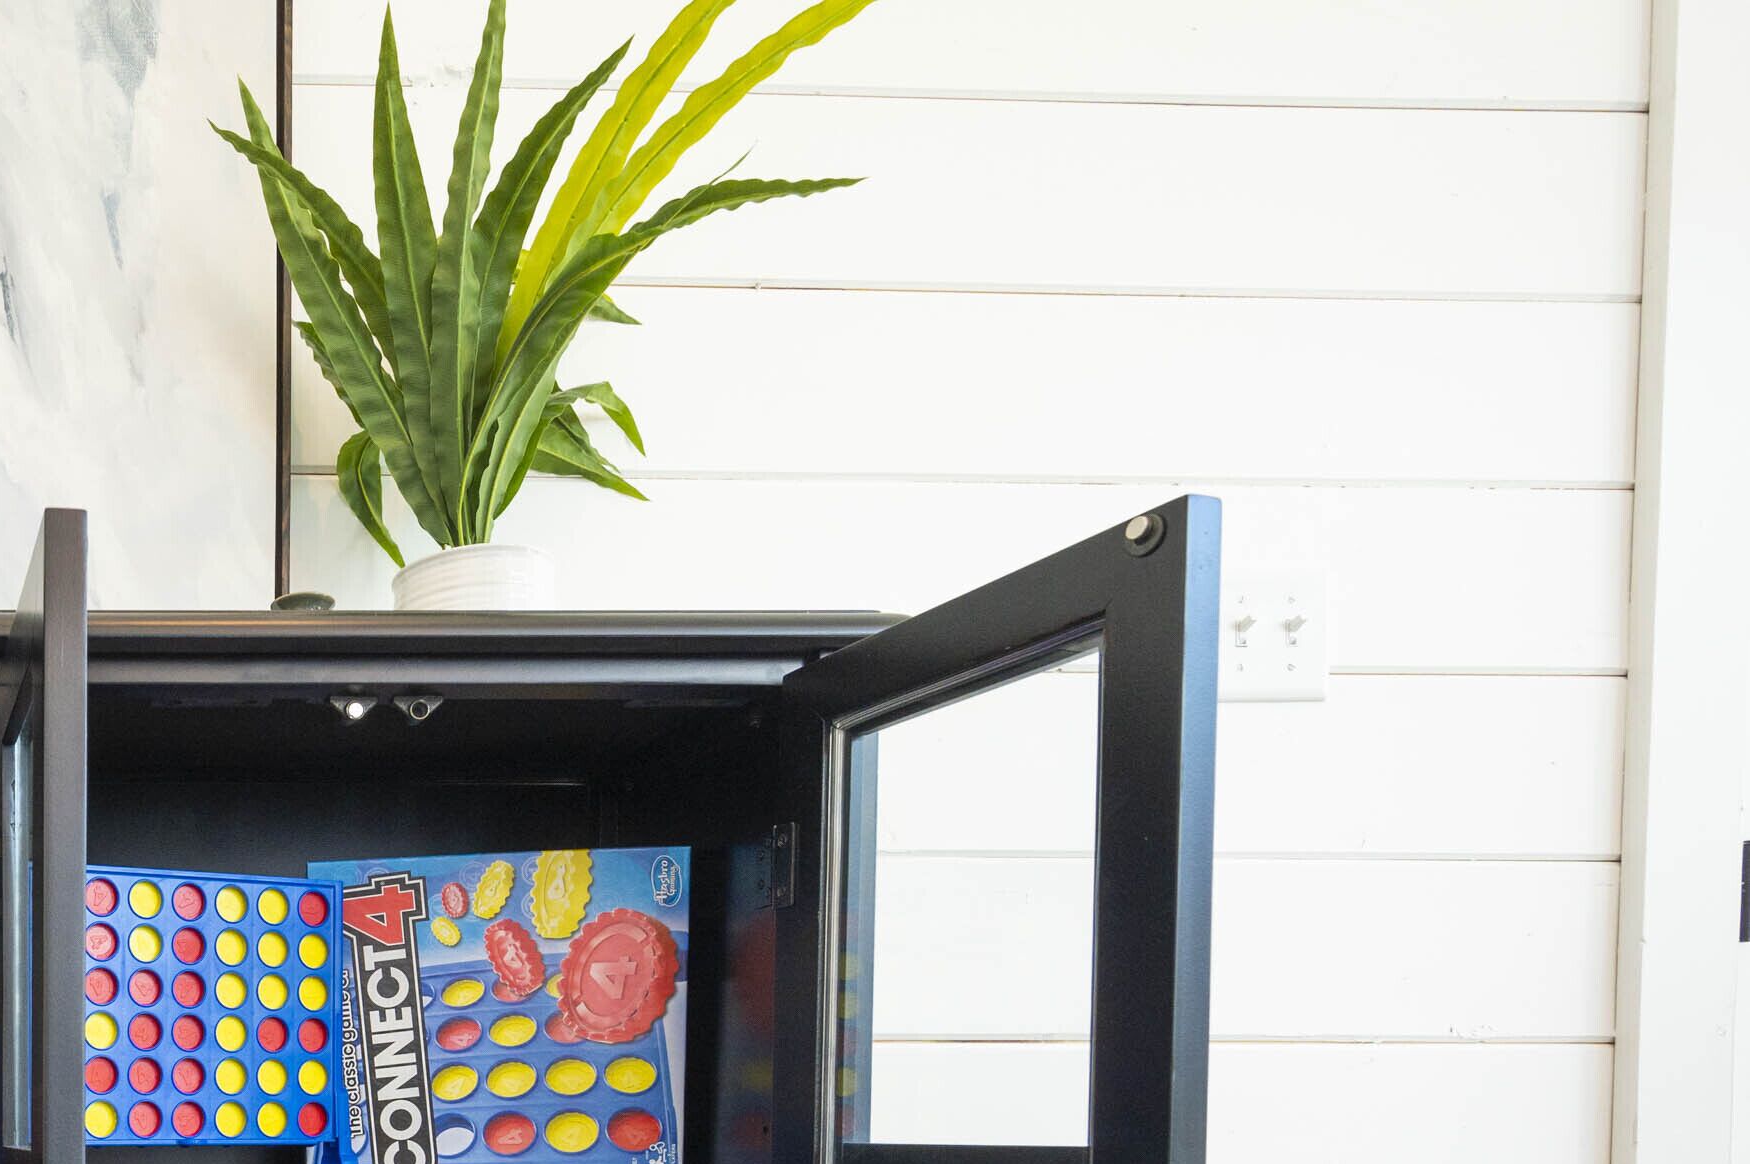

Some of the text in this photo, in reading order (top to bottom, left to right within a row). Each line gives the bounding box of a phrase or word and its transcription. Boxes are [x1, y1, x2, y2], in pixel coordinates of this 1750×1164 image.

[656, 860, 670, 904] Hasbro
[344, 884, 415, 946] 4
[590, 955, 637, 1000] 4
[343, 1045, 360, 1104] classic
[349, 1105, 362, 1138] The
